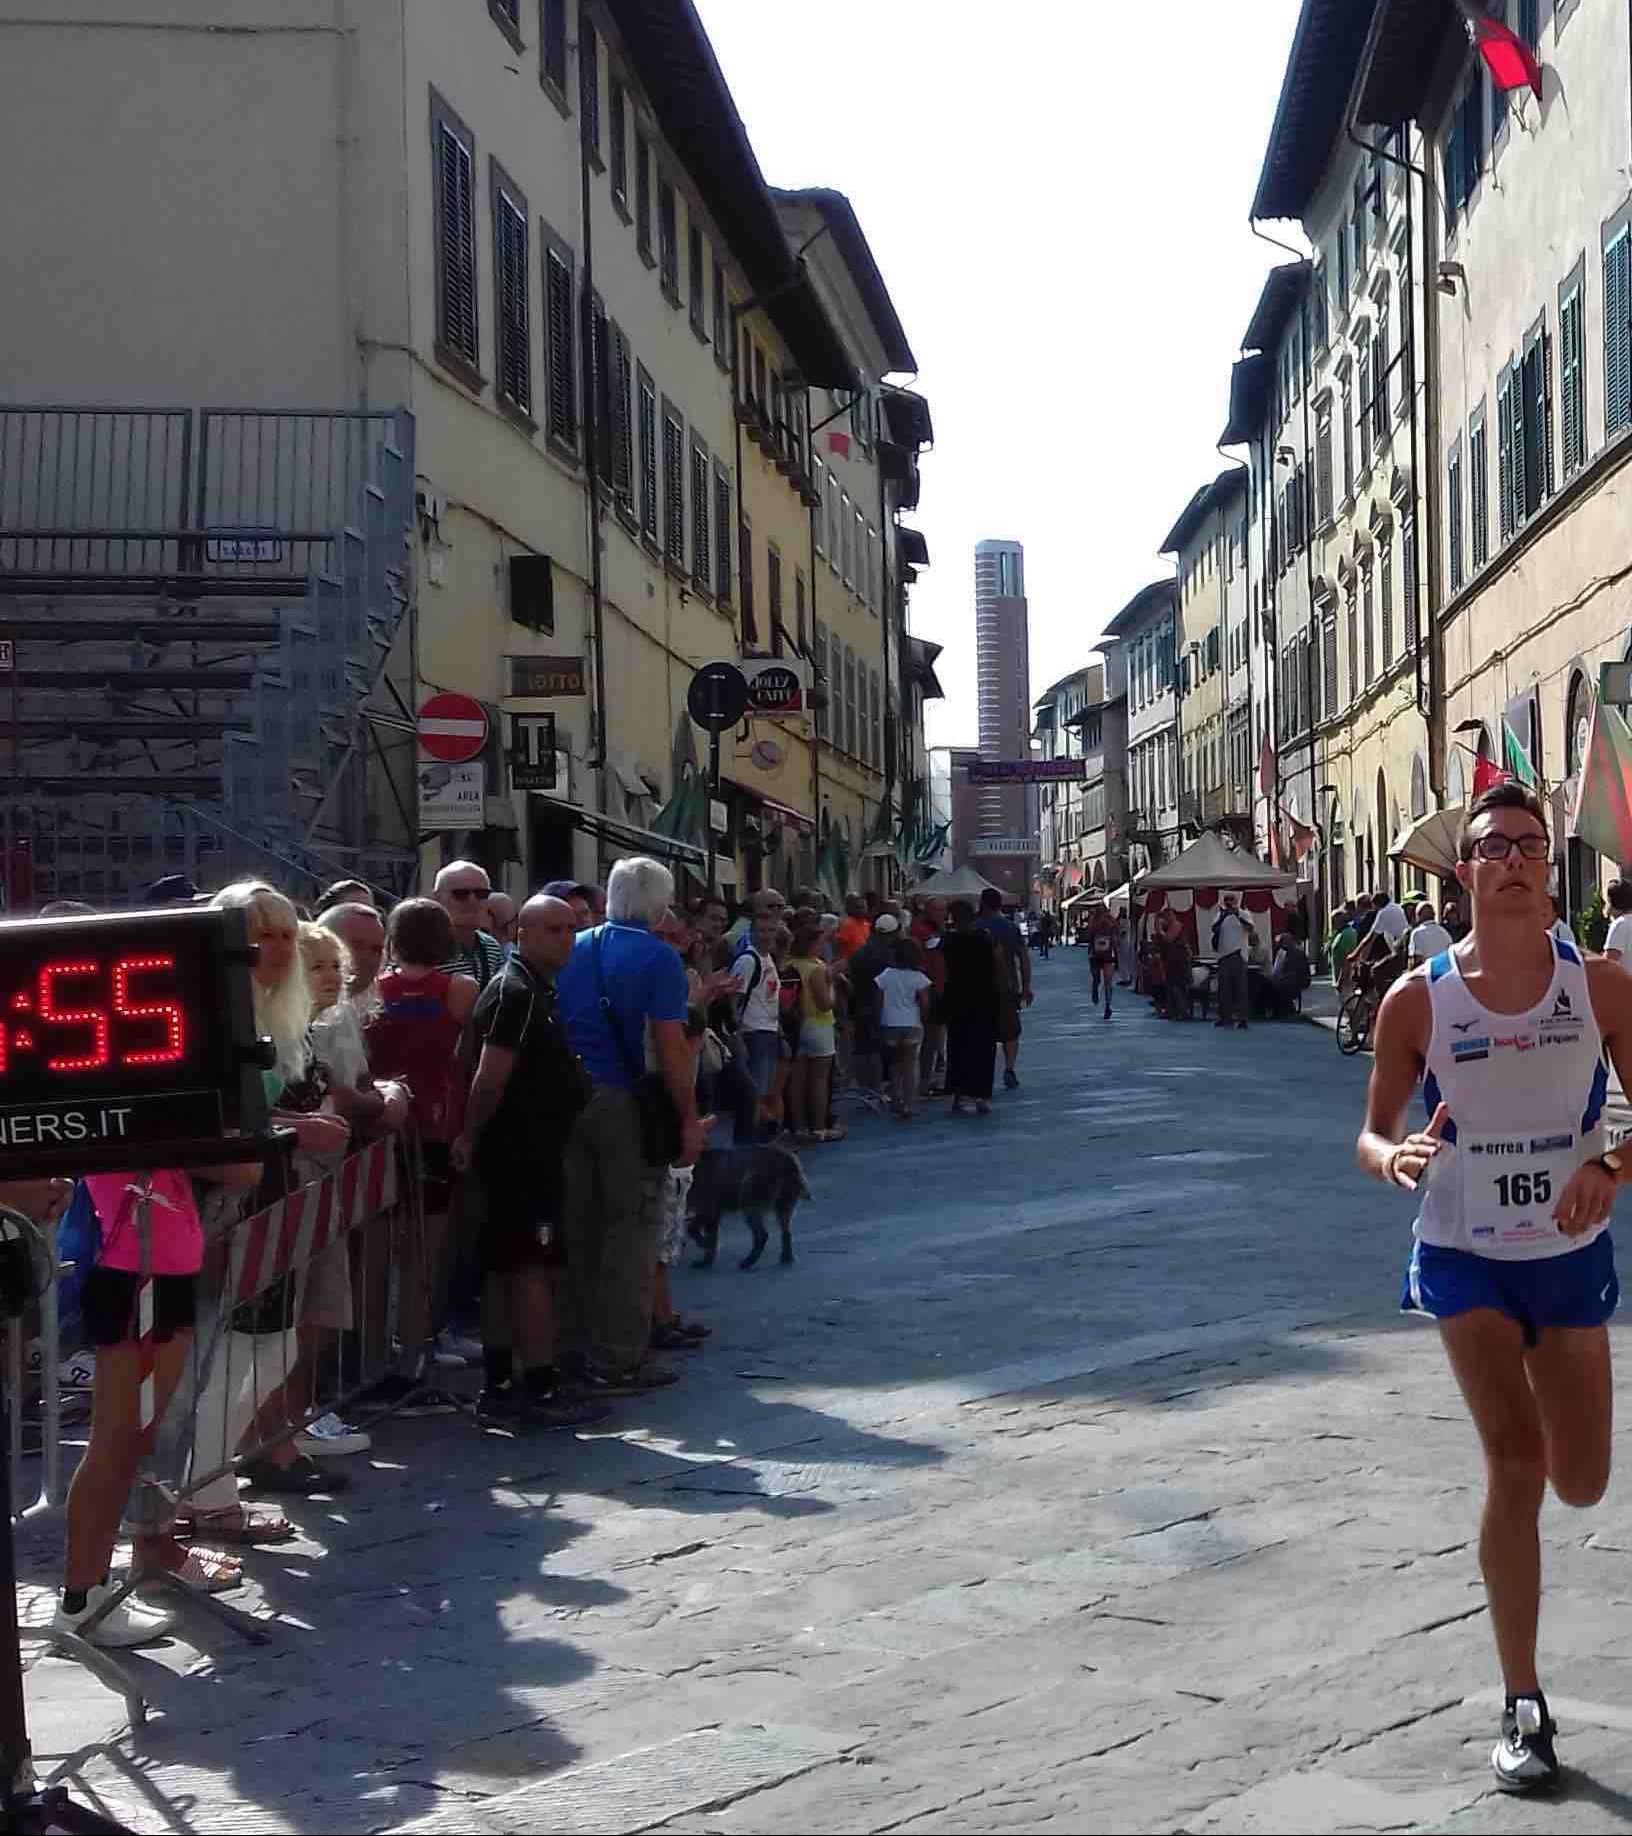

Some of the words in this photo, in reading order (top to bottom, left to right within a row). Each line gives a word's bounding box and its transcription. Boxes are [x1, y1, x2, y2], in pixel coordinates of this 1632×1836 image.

[518, 718, 549, 765] T
[0, 955, 184, 1072] :55
[1493, 1169, 1551, 1207] 165
